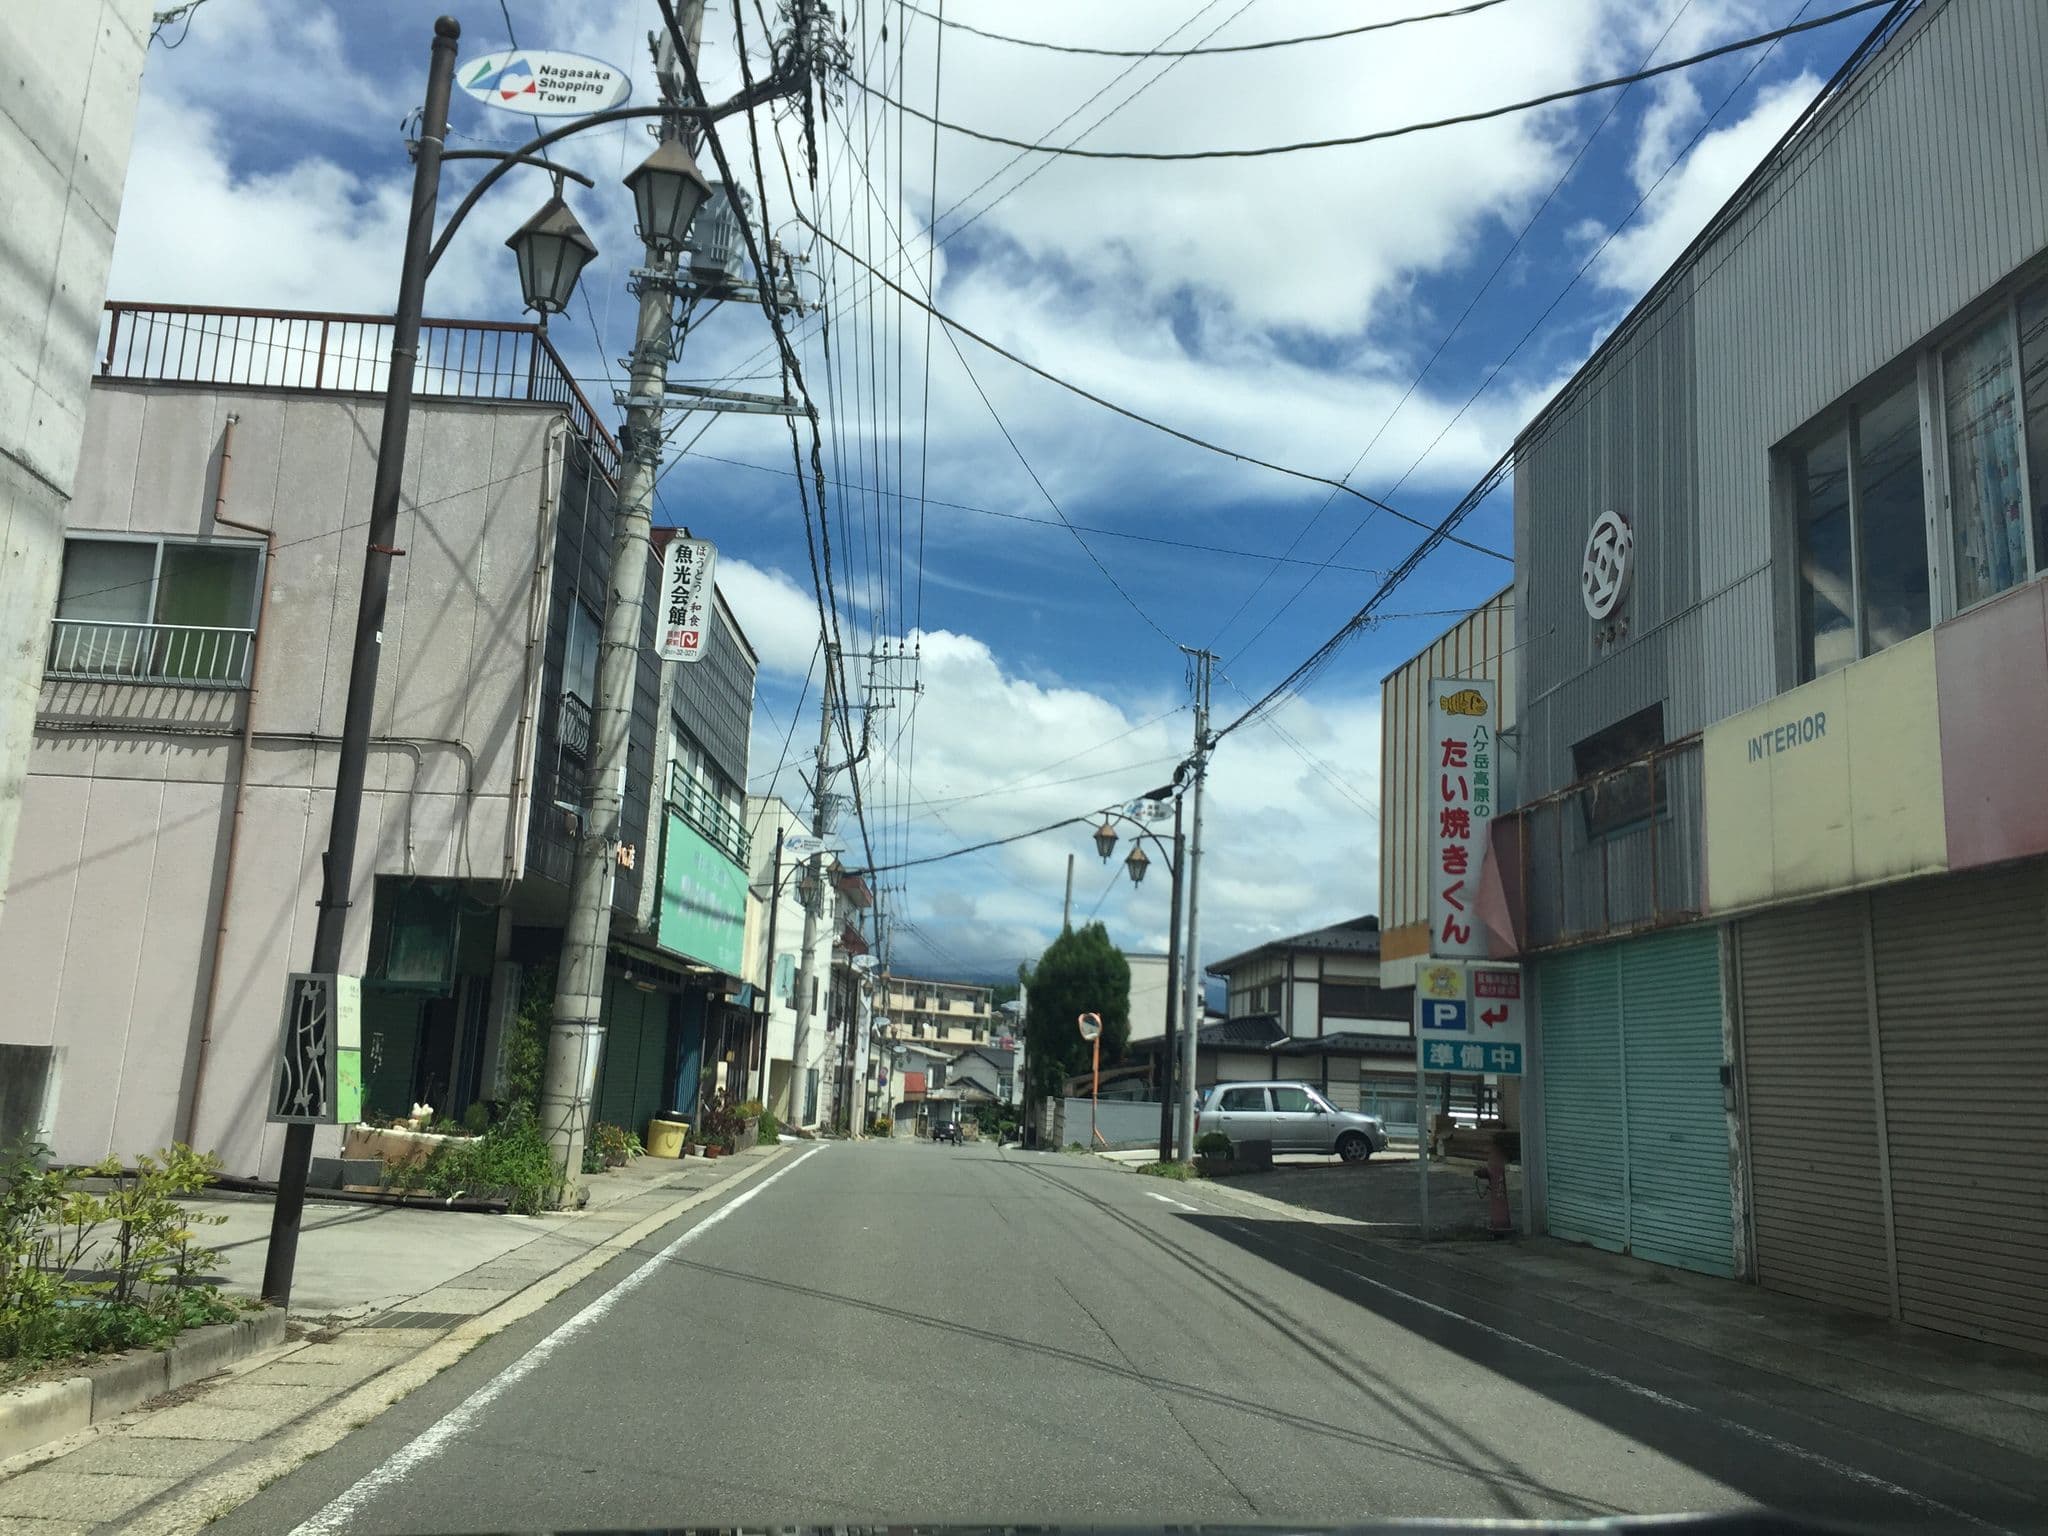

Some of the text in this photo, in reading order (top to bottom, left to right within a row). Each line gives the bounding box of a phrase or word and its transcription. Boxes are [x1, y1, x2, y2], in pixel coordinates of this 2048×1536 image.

[539, 65, 611, 81] Nagasaka
[538, 78, 604, 94] Shopping
[538, 91, 576, 103] Town
[668, 544, 693, 626] 魚光会館
[1747, 711, 1827, 763] INTERIOR
[1439, 737, 1471, 944] たい焼きくん
[1434, 1003, 1458, 1027] P
